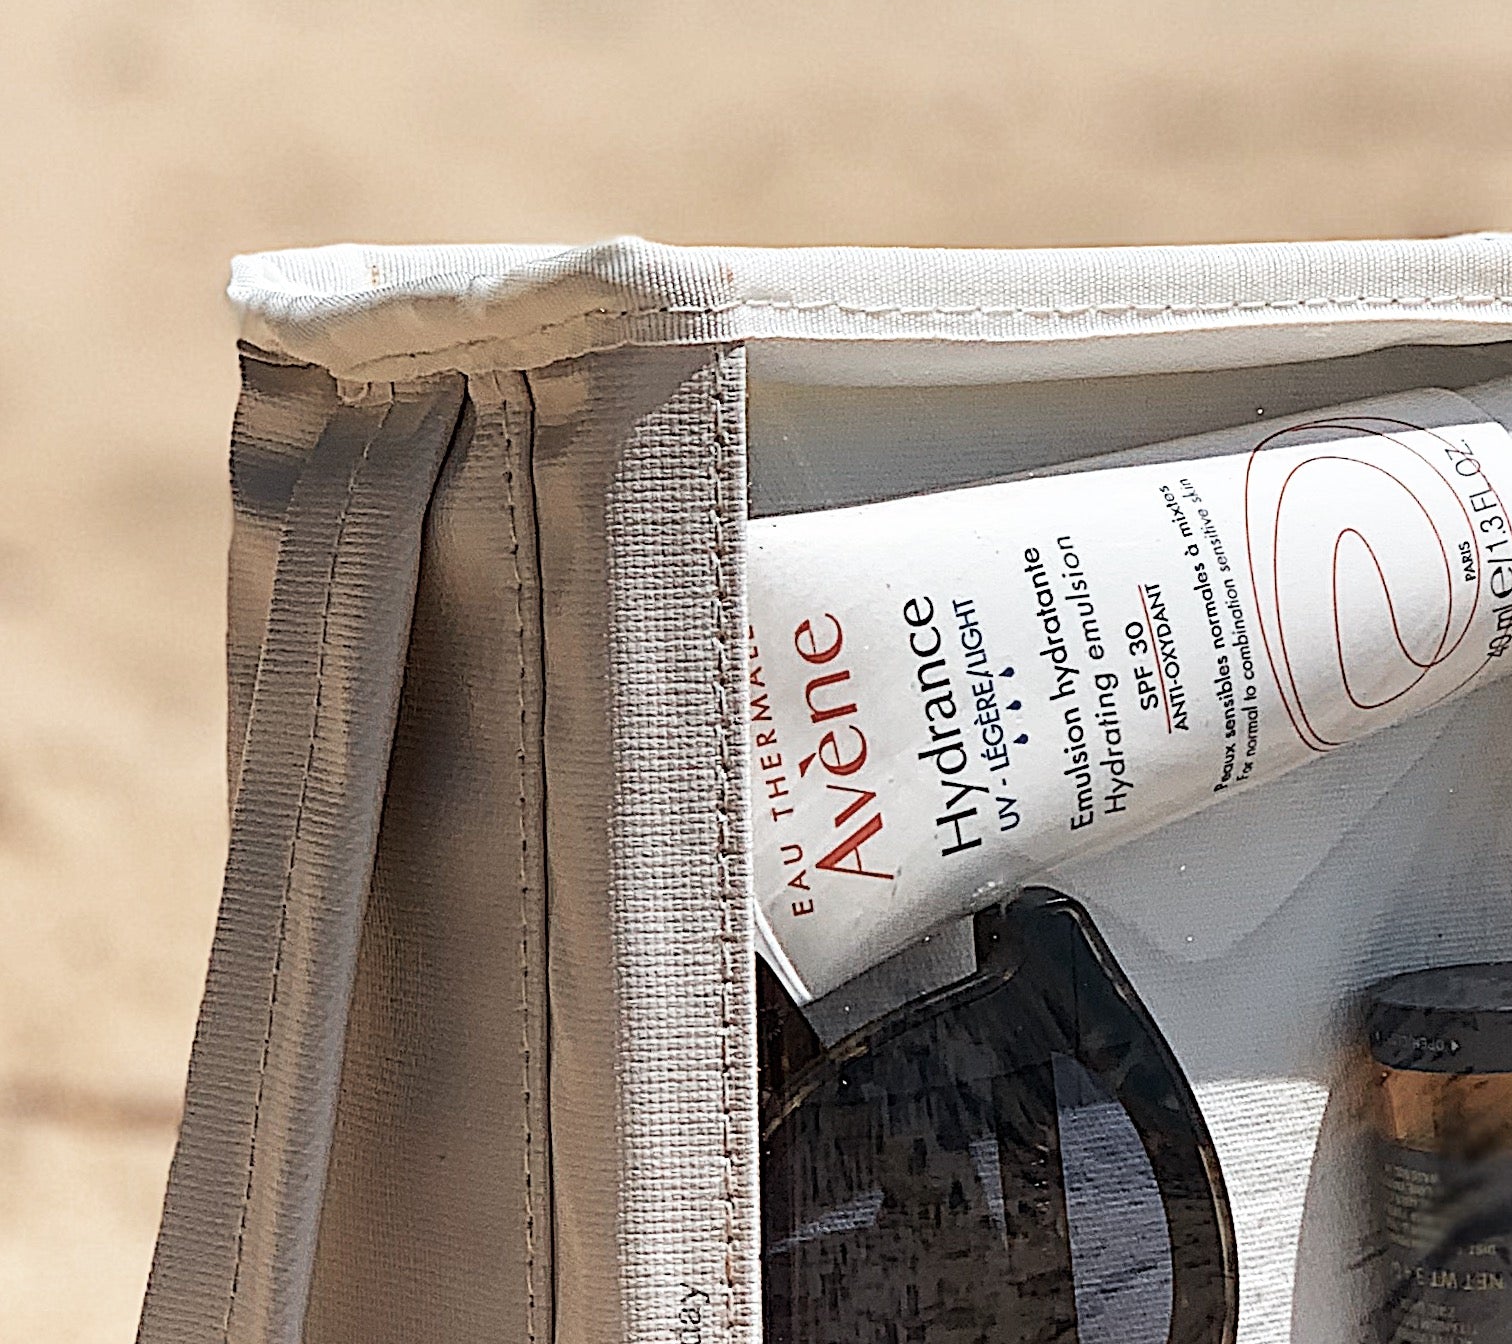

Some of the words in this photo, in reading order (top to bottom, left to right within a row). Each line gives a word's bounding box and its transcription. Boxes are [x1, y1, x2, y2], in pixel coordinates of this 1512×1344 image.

[1159, 485, 1193, 537] mixtes
[1179, 478, 1202, 503] skin
[1184, 543, 1200, 556] à
[1197, 508, 1231, 572] sensitive
[1458, 541, 1476, 582] PARIS
[1025, 547, 1080, 702] hydratante
[1057, 536, 1105, 660] emulsion
[1193, 562, 1226, 650] normales
[1224, 578, 1256, 681] combination
[1125, 621, 1148, 656] 30
[1144, 584, 1189, 731] ANTI-OXYDANT
[1133, 666, 1159, 711] SPF
[1213, 655, 1236, 738] sensibles
[1243, 685, 1257, 701] to
[749, 626, 795, 822] THERMA
[795, 612, 894, 880] Avène
[903, 596, 990, 856] Hydrance
[1090, 674, 1134, 814] Hydrating
[1240, 705, 1259, 757] normal
[1057, 703, 1092, 830] Emulsion
[1213, 743, 1236, 792] Peaux
[1236, 761, 1254, 782] For
[996, 797, 1020, 831] UV
[781, 843, 814, 916] EAU
[1463, 1272, 1505, 1292] NET
